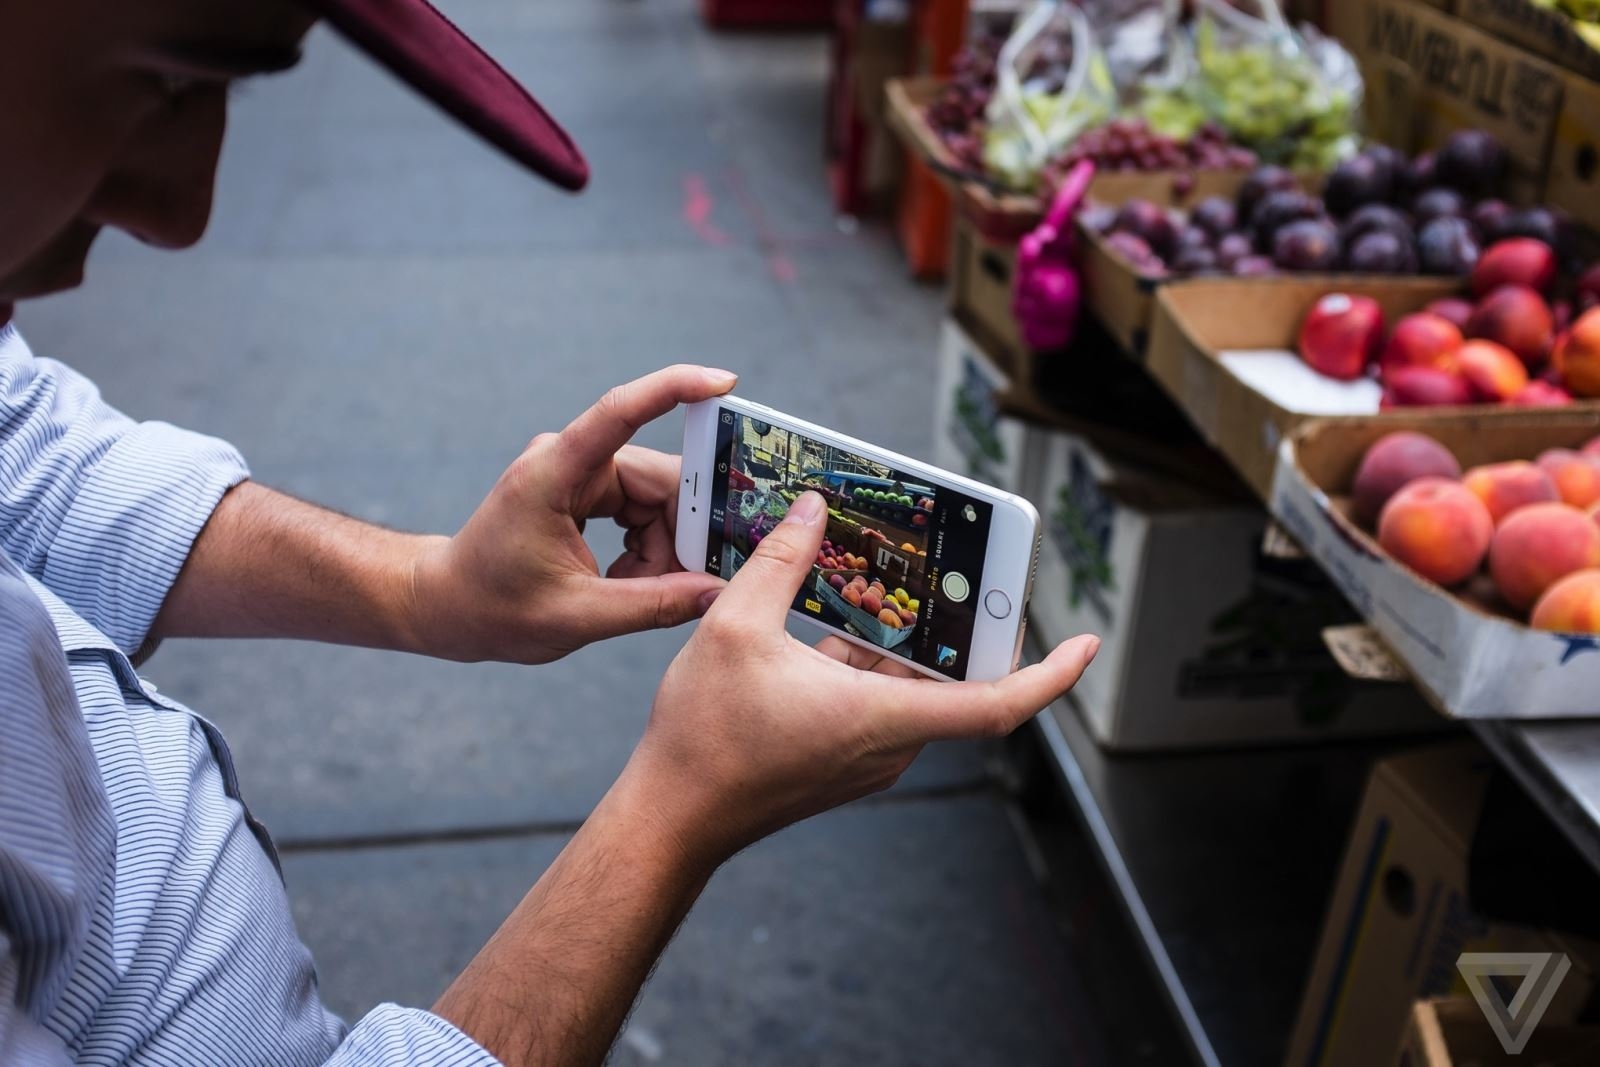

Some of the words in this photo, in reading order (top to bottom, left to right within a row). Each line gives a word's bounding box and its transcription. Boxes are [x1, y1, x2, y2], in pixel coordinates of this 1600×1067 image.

[935, 531, 945, 559] SQUARE
[930, 567, 939, 591] PHOTO
[806, 599, 820, 611] HDR
[926, 598, 935, 619] VIDEO
